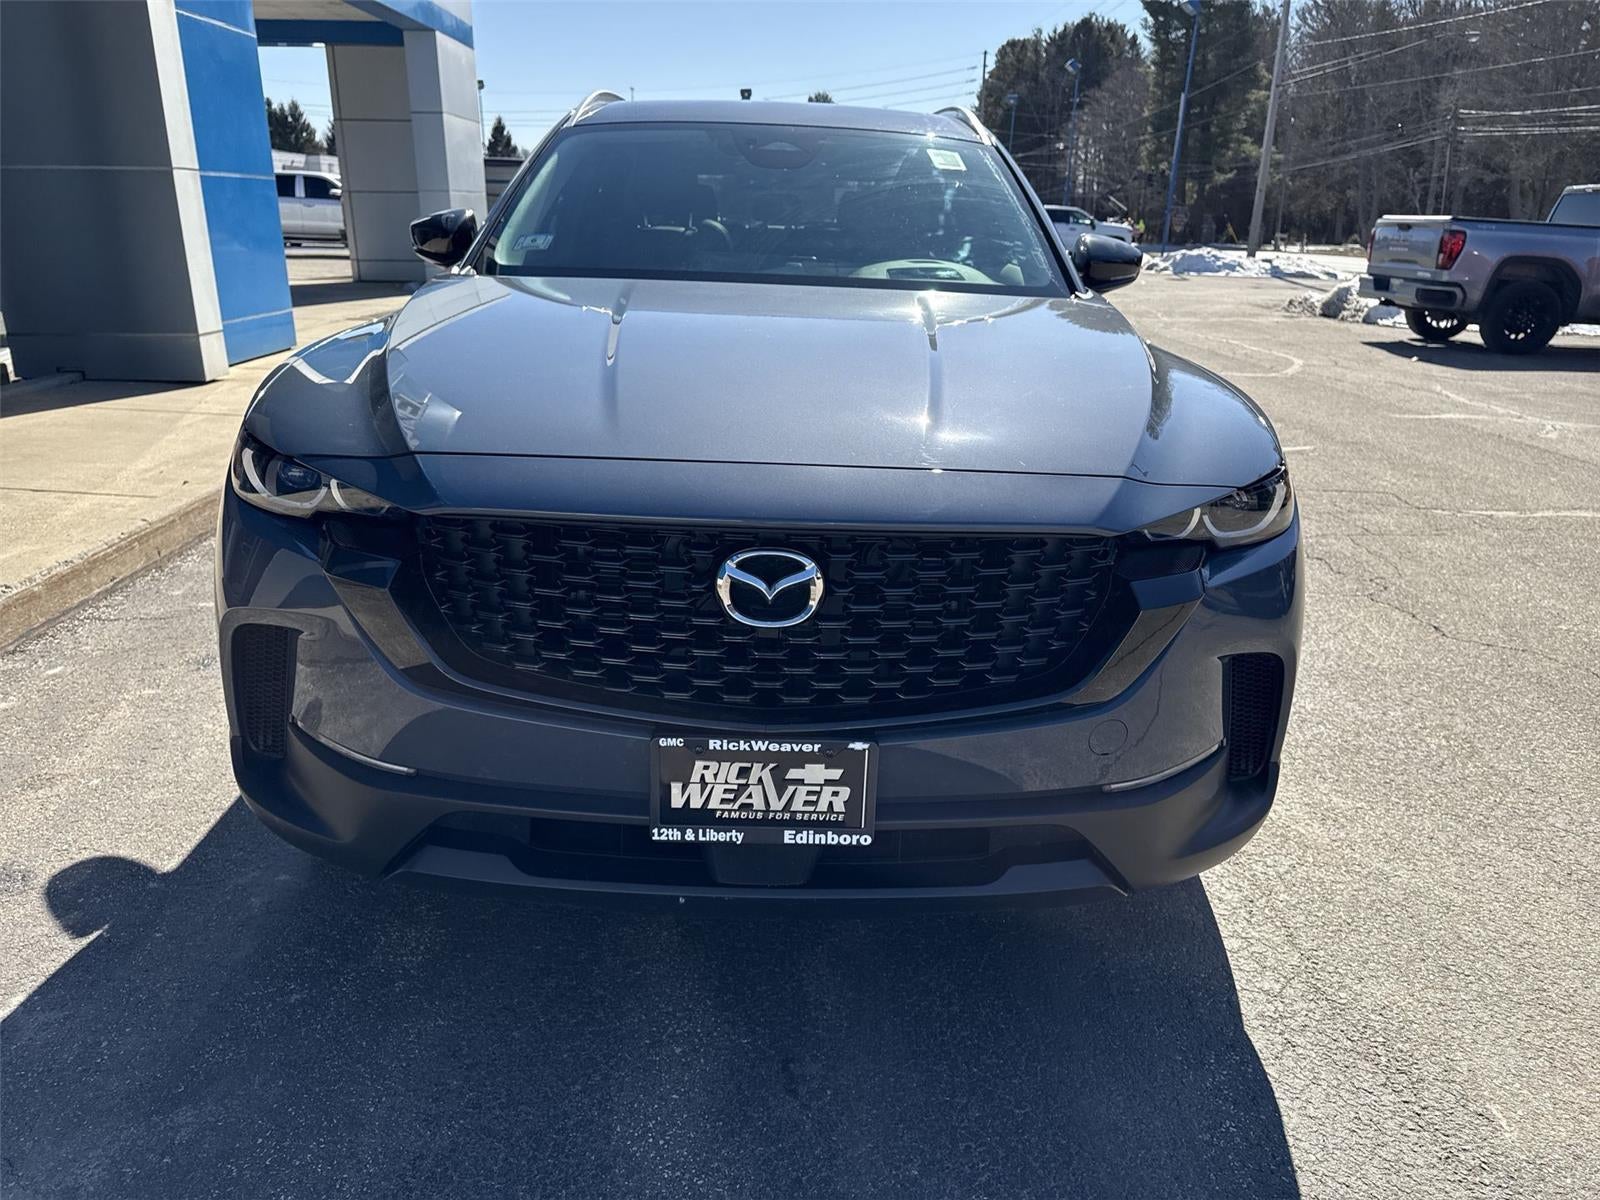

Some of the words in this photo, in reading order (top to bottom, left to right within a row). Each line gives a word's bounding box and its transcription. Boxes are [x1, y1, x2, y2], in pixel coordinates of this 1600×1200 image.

[659, 738, 684, 747] GMC
[690, 760, 780, 785] RICK
[670, 781, 851, 813] WEAVER
[715, 810, 763, 820] FAMOUS
[768, 812, 791, 821] FOR
[796, 813, 845, 822] SERVICE
[651, 828, 682, 841] 12th
[684, 829, 695, 841] &
[698, 829, 744, 844] Liberty
[783, 830, 873, 846] Edinboro
